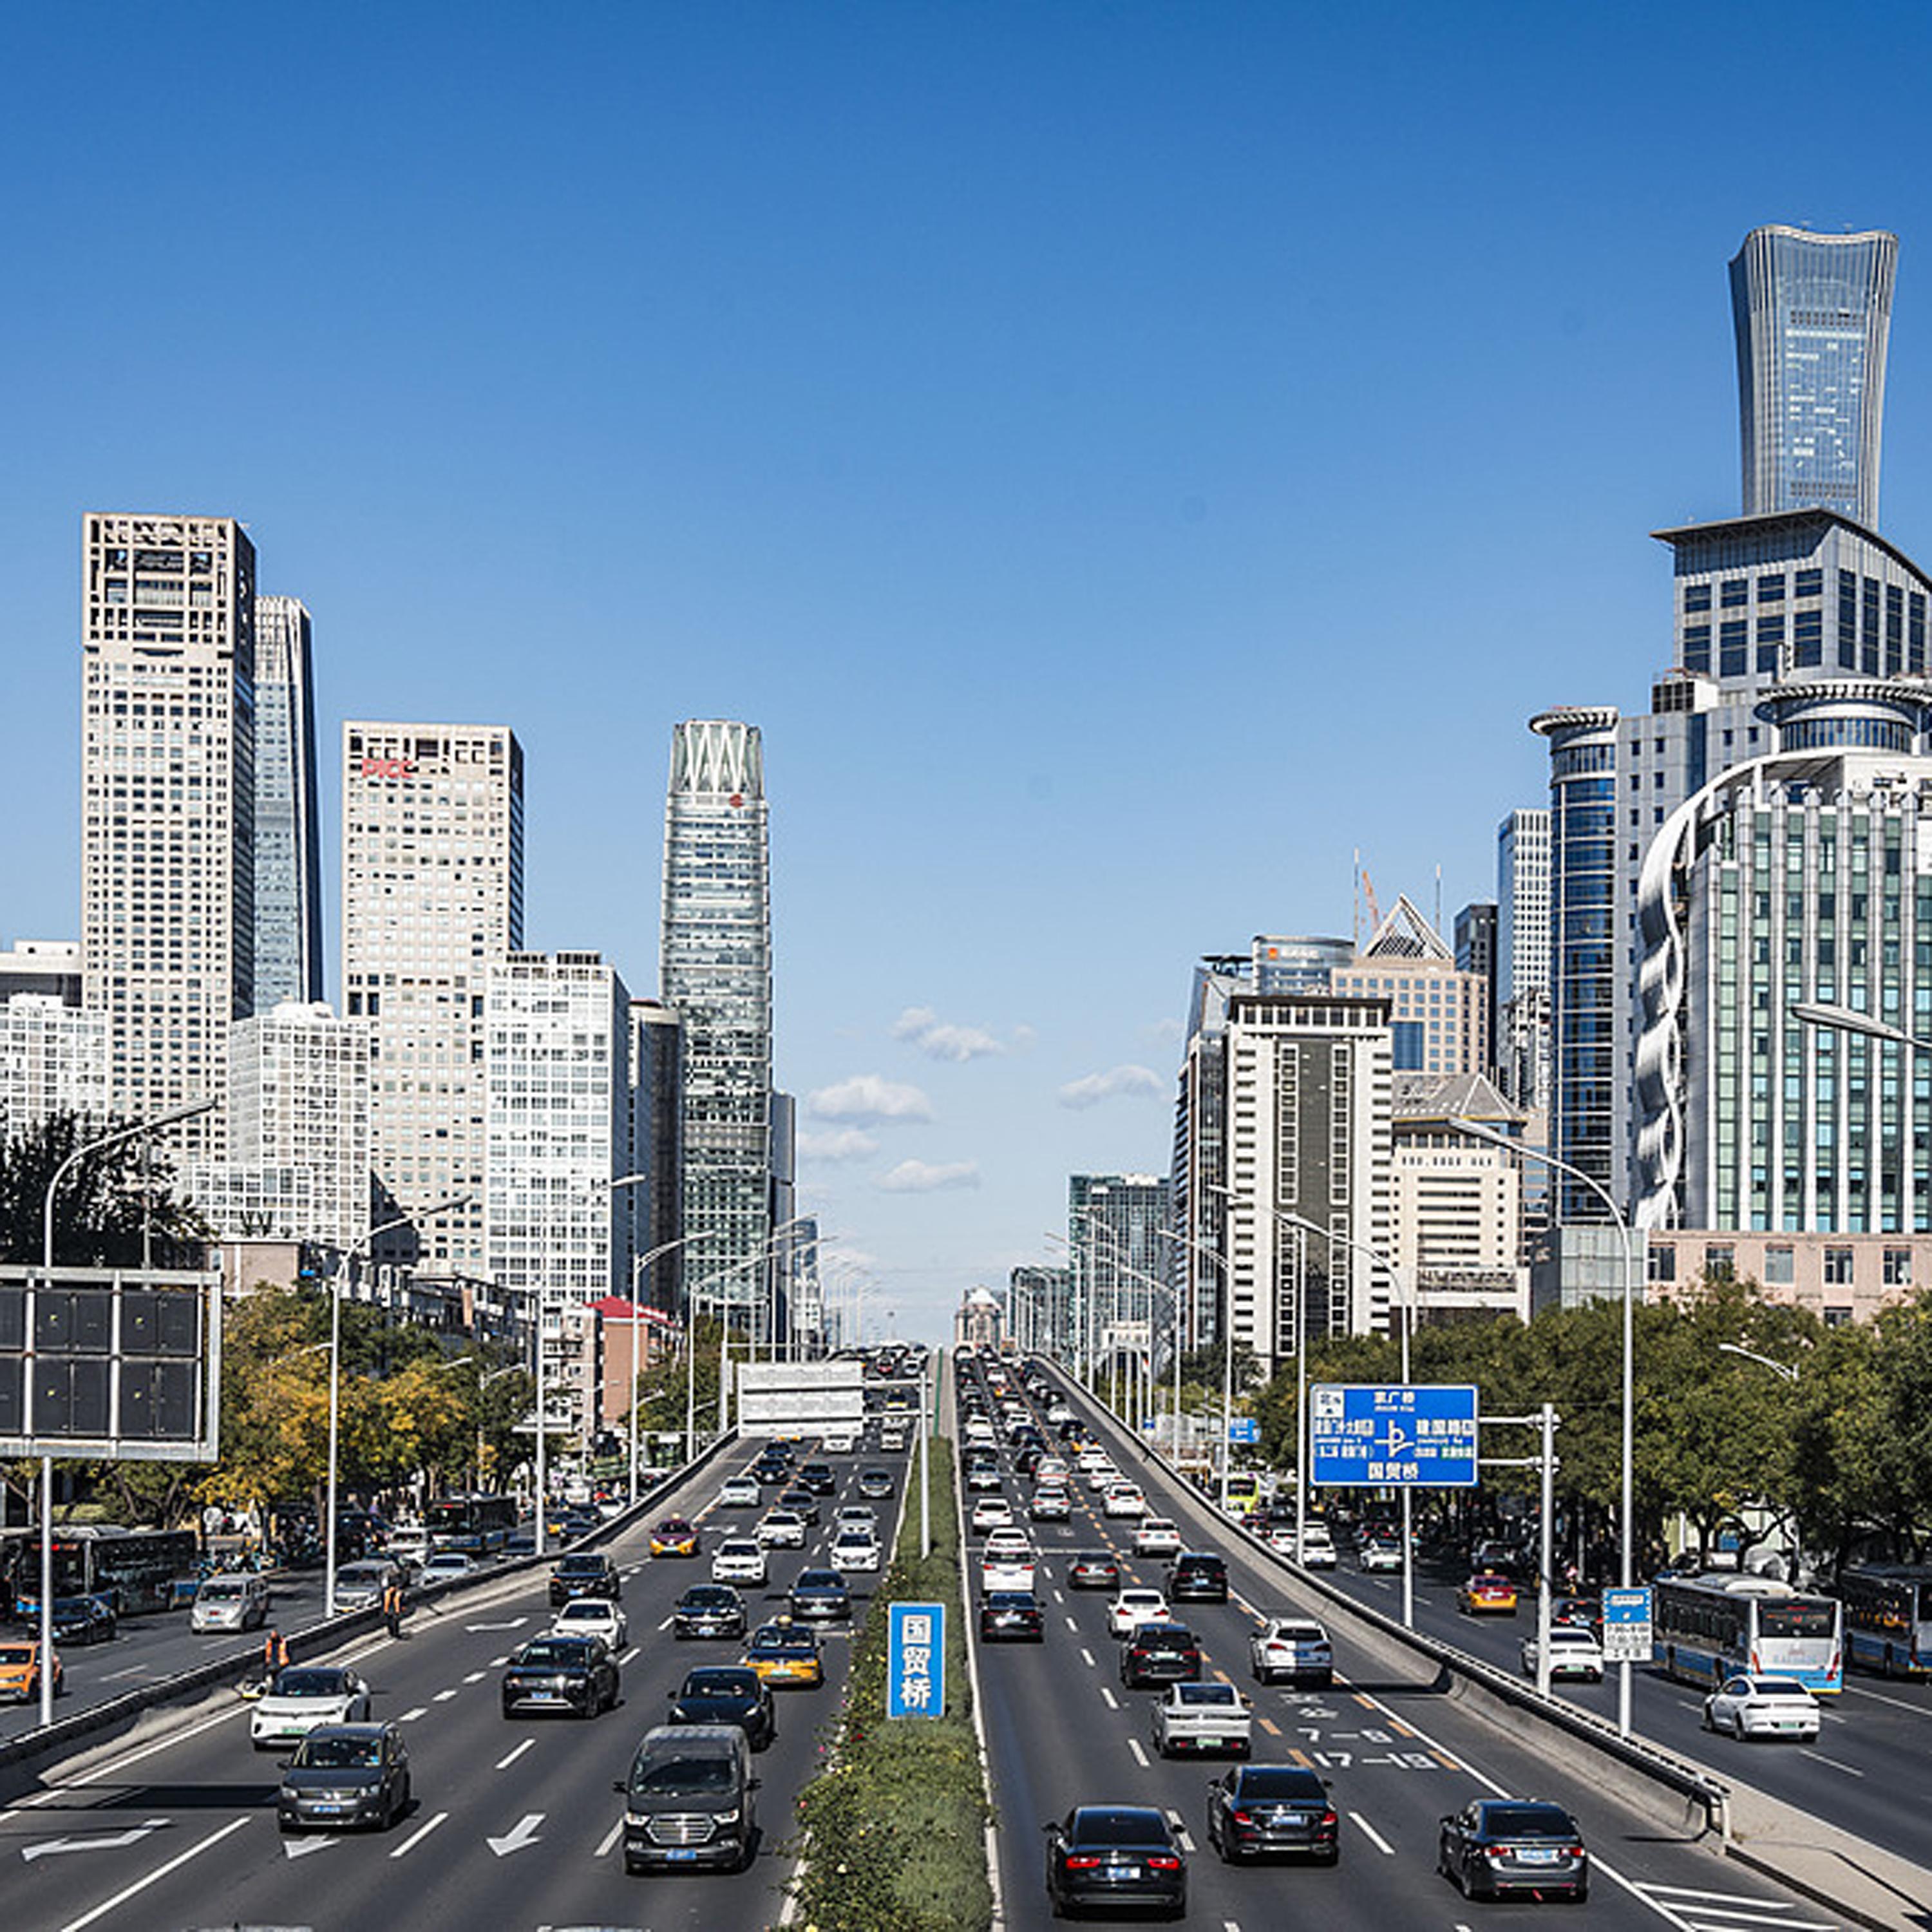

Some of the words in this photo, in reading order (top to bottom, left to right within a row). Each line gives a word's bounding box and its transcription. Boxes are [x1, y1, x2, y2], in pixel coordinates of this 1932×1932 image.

[362, 758, 413, 779] PICC
[1368, 1462, 1419, 1480] 国贸桥
[900, 1615, 931, 1709] 国贸桥
